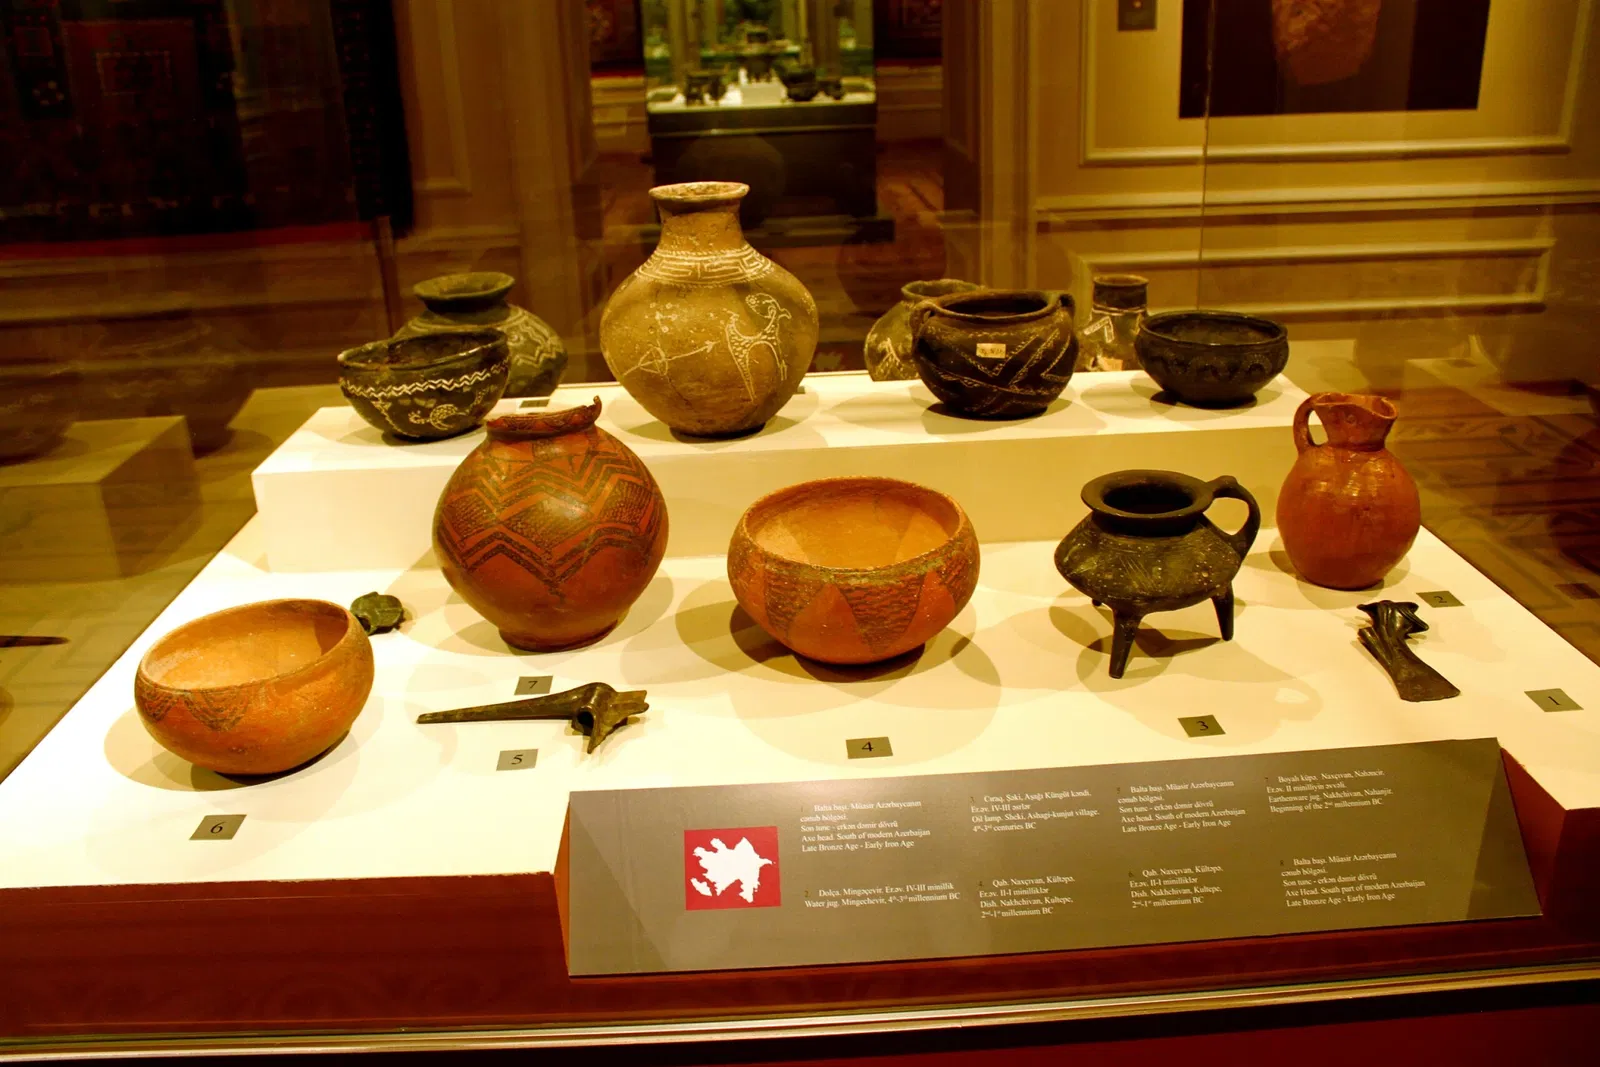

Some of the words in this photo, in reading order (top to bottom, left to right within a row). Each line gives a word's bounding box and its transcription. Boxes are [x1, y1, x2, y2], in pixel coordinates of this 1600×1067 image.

[1433, 595, 1447, 603] 2
[527, 680, 539, 690] 7
[1547, 696, 1560, 705] 1
[1198, 720, 1209, 731] 3
[861, 741, 874, 752] 4
[510, 754, 523, 765] 5
[1286, 784, 1291, 792] II
[1268, 794, 1308, 803] Earthenware
[1119, 805, 1132, 813] Son
[1270, 804, 1303, 814] Beginning
[1305, 802, 1311, 810] of
[1335, 799, 1371, 808] millennium
[1372, 797, 1383, 805] BC
[972, 815, 982, 823] Oil
[1121, 815, 1135, 823] Axe
[1155, 812, 1174, 820] South
[1176, 811, 1183, 819] of
[1185, 810, 1209, 818] modern
[1211, 808, 1246, 817] Azerbaijan
[210, 821, 226, 834] 6
[801, 824, 814, 832] Son
[994, 823, 1024, 831] centuries
[1025, 821, 1036, 829] BC
[1164, 822, 1177, 831] Age
[1183, 820, 1201, 829] Early
[1217, 819, 1231, 828] Age
[837, 832, 856, 840] South
[859, 831, 866, 839] of
[894, 829, 930, 838] Azerbaijan
[845, 842, 859, 852] Age
[865, 841, 882, 850] Early
[885, 840, 898, 848] Iron
[901, 840, 914, 849] Age
[1286, 889, 1298, 897] Axe
[1321, 885, 1340, 894] South
[1342, 885, 1354, 894] part
[1365, 882, 1389, 890] modern
[1390, 880, 1425, 889] Azerbaijan
[909, 894, 947, 902] millennium
[949, 892, 960, 900] BC
[1153, 898, 1191, 906] millennium
[1193, 896, 1204, 904] BC
[1286, 899, 1301, 907] Late
[1328, 896, 1340, 905] Age
[1347, 894, 1364, 903] Early
[1382, 892, 1395, 901] Age
[1001, 908, 1040, 917] millennium
